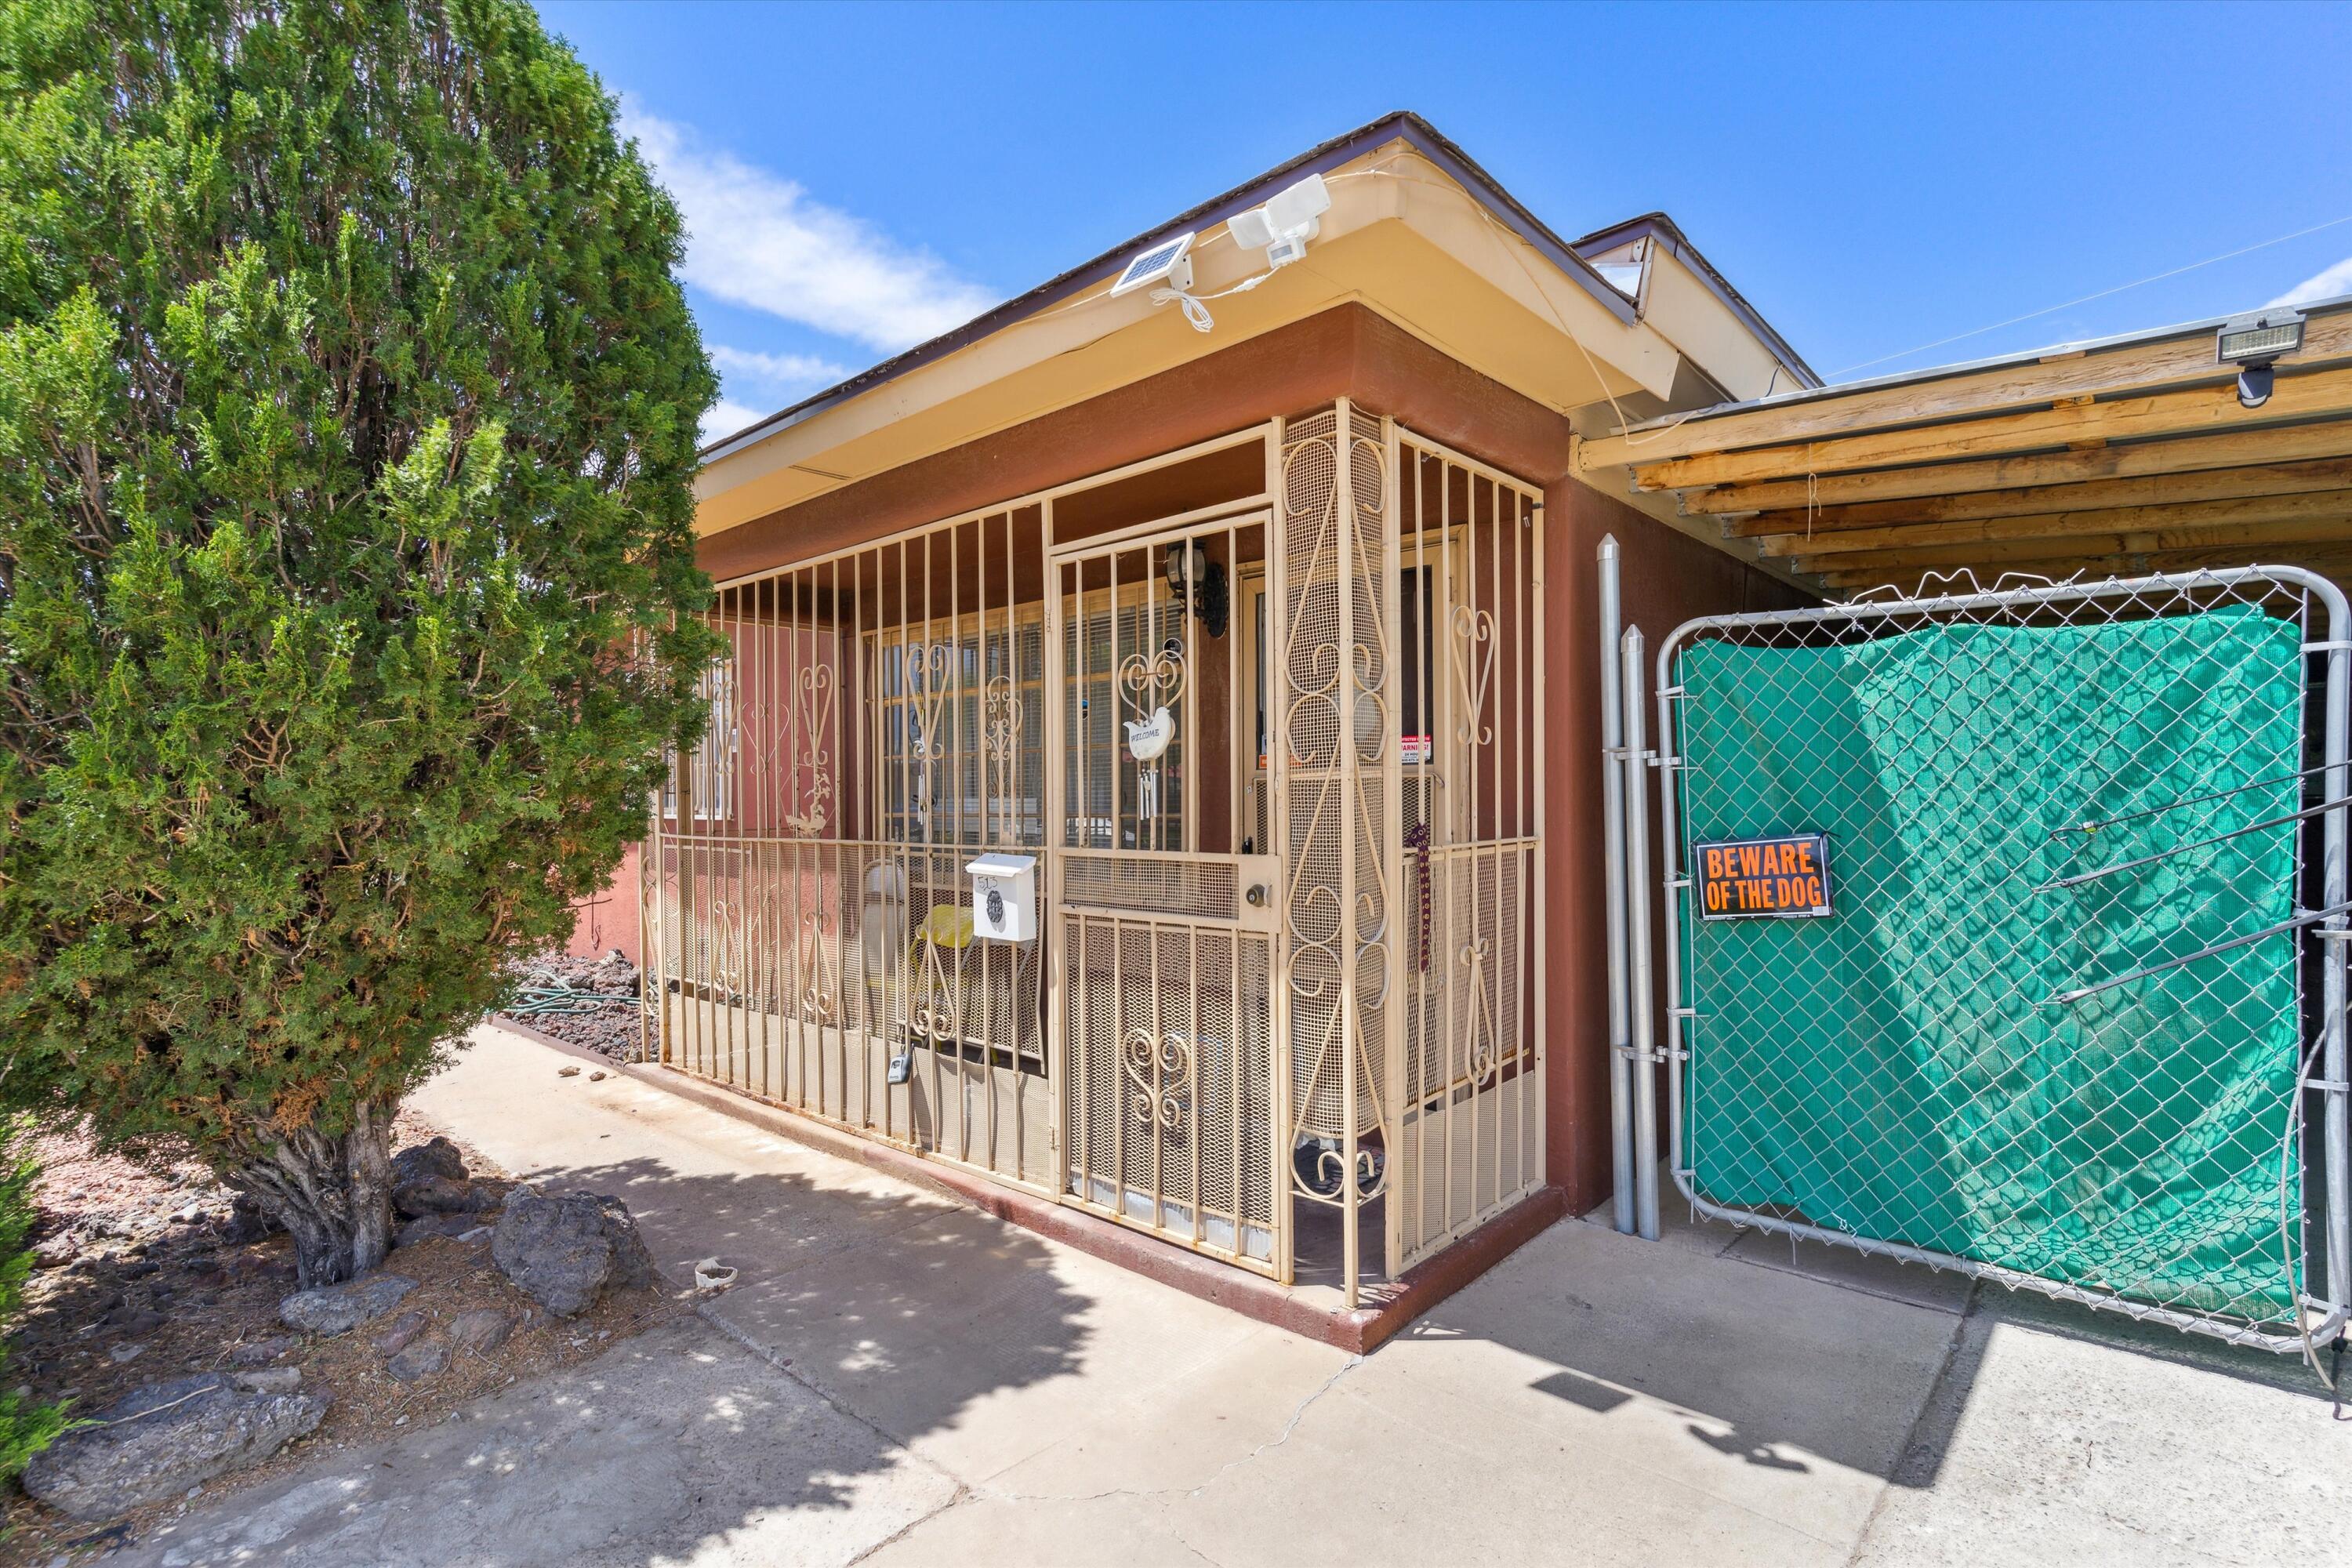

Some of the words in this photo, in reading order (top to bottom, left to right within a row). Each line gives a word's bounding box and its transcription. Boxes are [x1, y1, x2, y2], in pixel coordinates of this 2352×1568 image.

[1131, 729, 1160, 742] WELCOME
[1706, 842, 1815, 879] BEWARE
[1706, 881, 1731, 911] OF
[1734, 879, 1775, 909] THE
[1776, 876, 1823, 908] DOG
